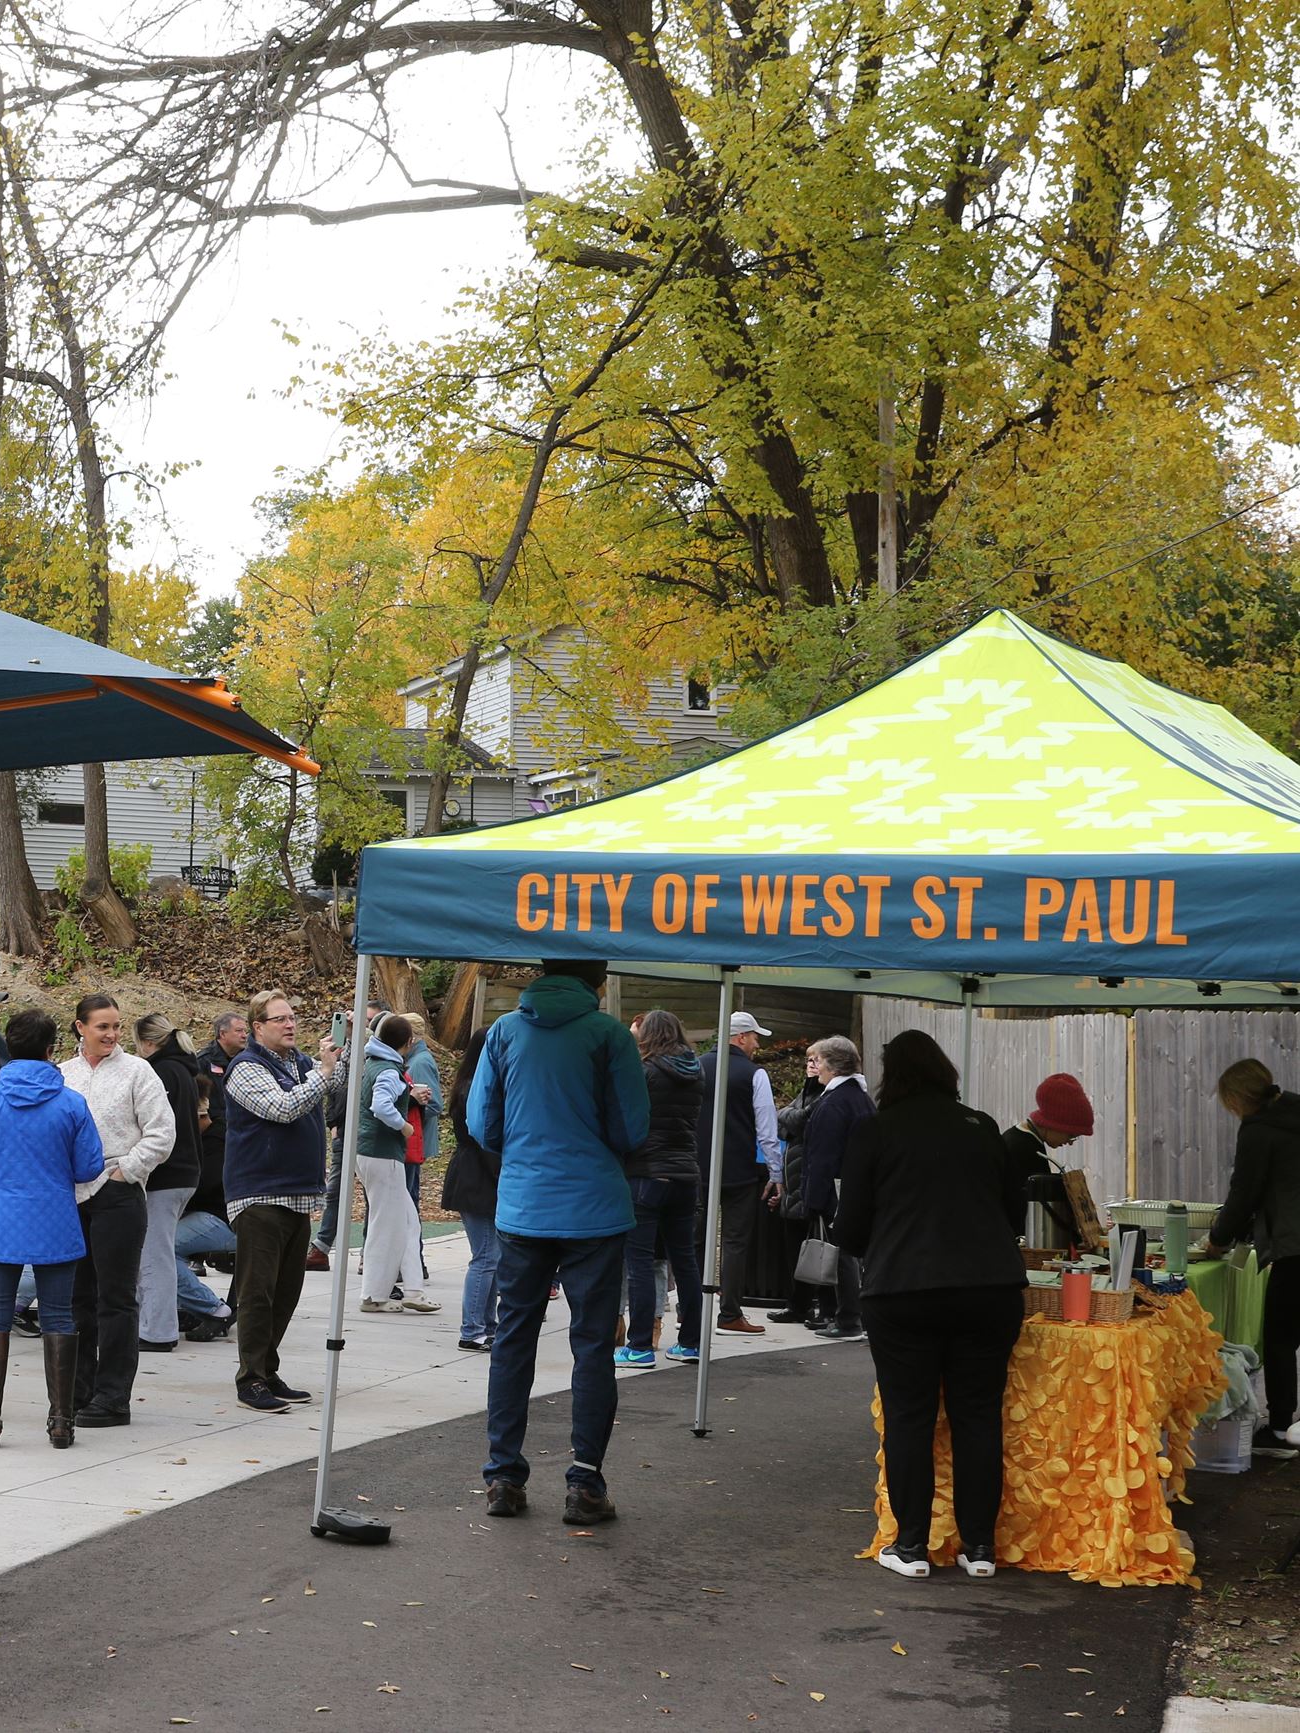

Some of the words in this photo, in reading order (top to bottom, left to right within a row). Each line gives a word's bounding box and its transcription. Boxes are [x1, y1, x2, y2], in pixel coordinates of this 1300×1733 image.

[516, 873, 633, 932] CITY
[652, 873, 720, 934] OF
[741, 874, 892, 937] WEST
[911, 875, 997, 940] ST.
[1024, 877, 1188, 946] PAUL
